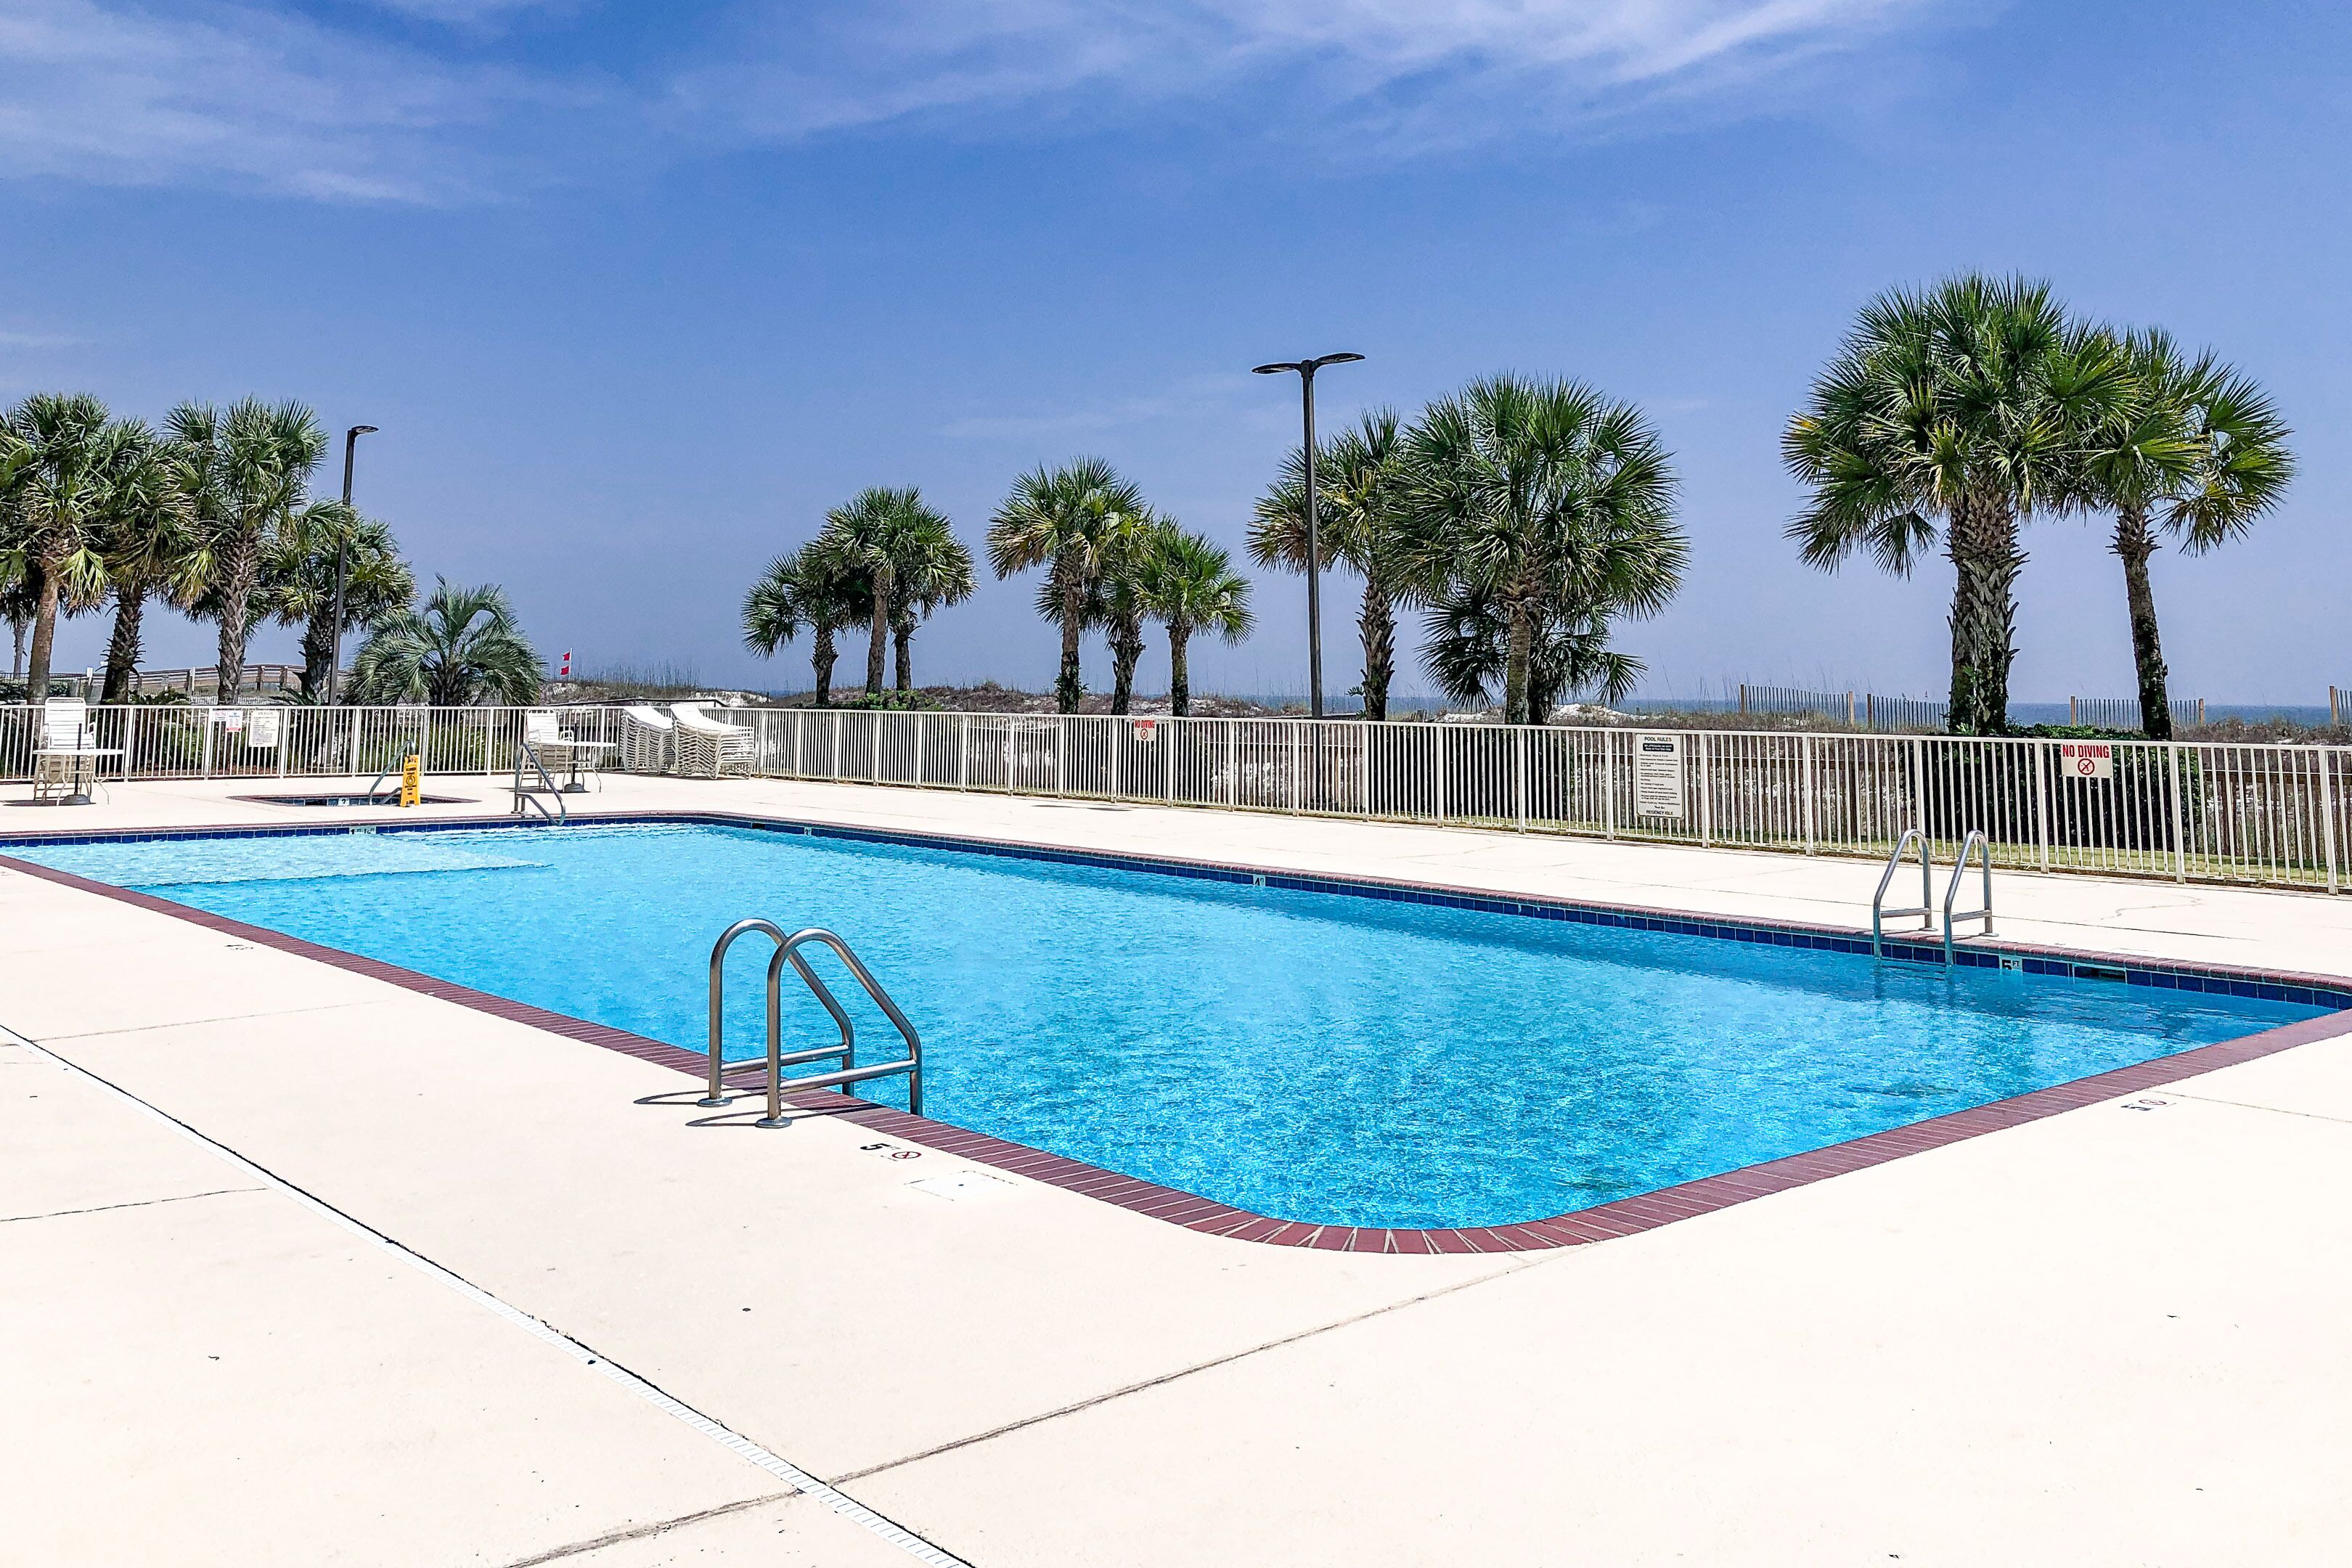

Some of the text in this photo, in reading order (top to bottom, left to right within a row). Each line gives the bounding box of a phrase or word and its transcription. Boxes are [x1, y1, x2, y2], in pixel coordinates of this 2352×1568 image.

[2062, 745, 2110, 759] NO DIVING
[2001, 959, 2012, 970] 5
